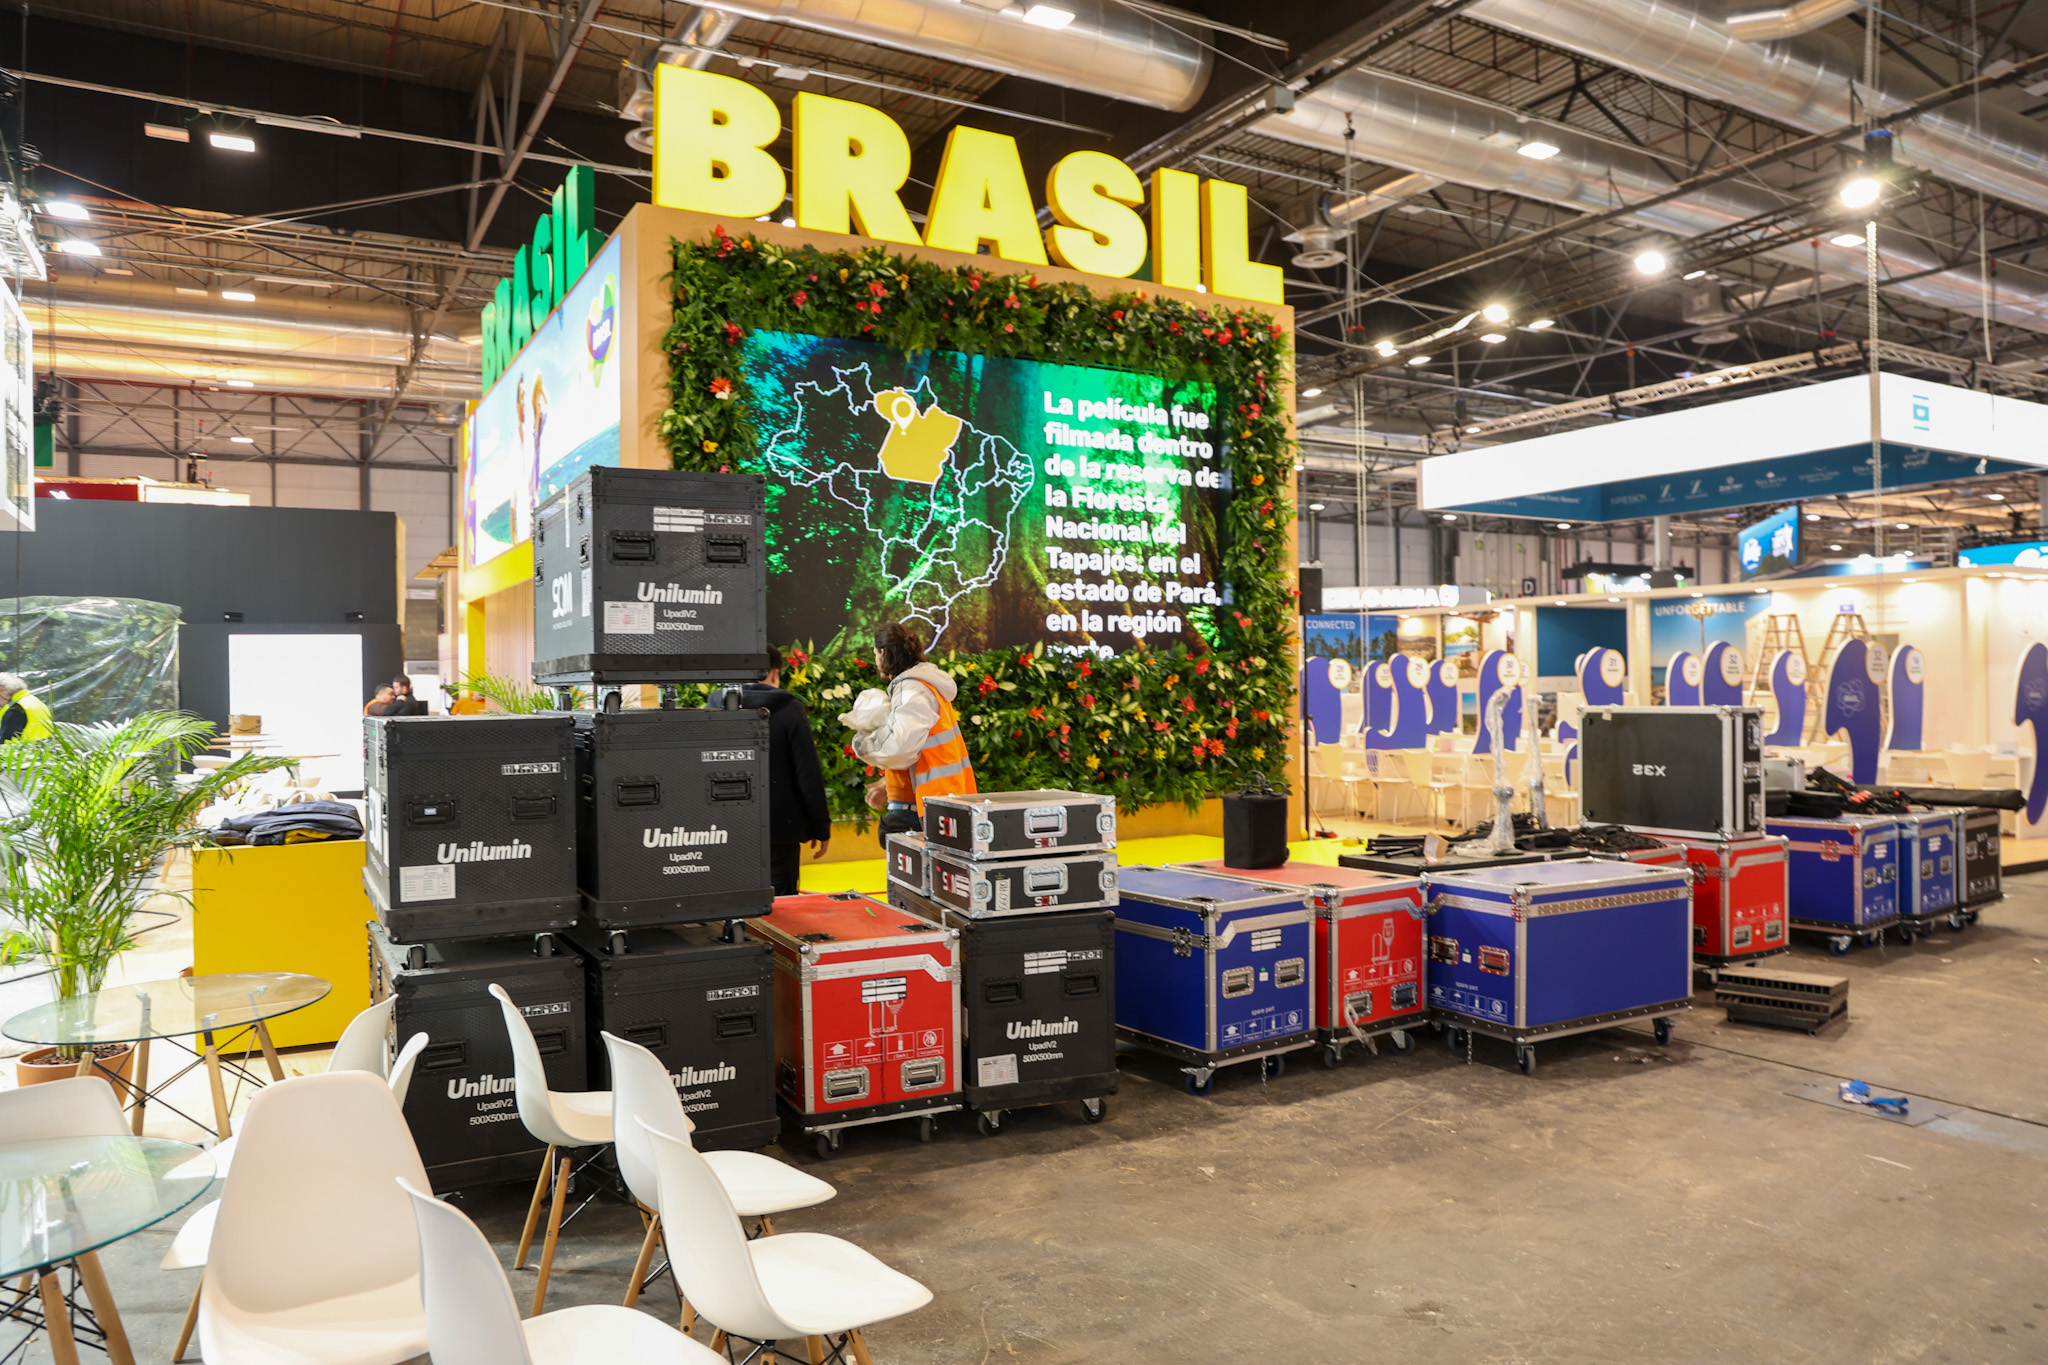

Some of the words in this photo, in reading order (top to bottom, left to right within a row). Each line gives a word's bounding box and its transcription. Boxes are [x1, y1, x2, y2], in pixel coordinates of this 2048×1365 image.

[653, 62, 1284, 306] BRASIL
[481, 164, 600, 400] BRASIL
[1044, 391, 1074, 415] La
[1078, 397, 1169, 426] película
[1171, 404, 1209, 430] fue
[1044, 421, 1134, 451] filmada
[1137, 432, 1213, 459] dentro
[1044, 453, 1075, 477] de
[1079, 456, 1101, 479] la
[1105, 463, 1192, 487] reserva
[1045, 484, 1067, 507] la
[1072, 486, 1169, 514] Floresta
[1045, 515, 1149, 541] Nacional
[1152, 522, 1187, 545] del
[1045, 546, 1145, 576] Tapajós,
[1148, 555, 1177, 574] en
[1180, 553, 1201, 575] el
[637, 582, 723, 605] Unilumin
[1045, 578, 1129, 602] estado
[1133, 580, 1162, 603] de
[1166, 581, 1223, 606] Pará,
[1524, 581, 1534, 594] D
[1654, 601, 1746, 616] UNFORGETTABLE
[656, 622, 704, 631] 500X500mm
[1046, 613, 1078, 632] en
[1081, 608, 1103, 632] la
[1107, 609, 1182, 638] región
[1305, 619, 1356, 630] CONNECTED
[642, 824, 728, 848] Unilumin
[437, 838, 532, 864] Unilumin
[662, 865, 710, 875] 500X500mm
[1006, 1016, 1079, 1040] Unilumin
[1022, 1052, 1063, 1064] 500X500mm
[447, 1074, 516, 1100] Unilum
[666, 1061, 736, 1088] nilumin
